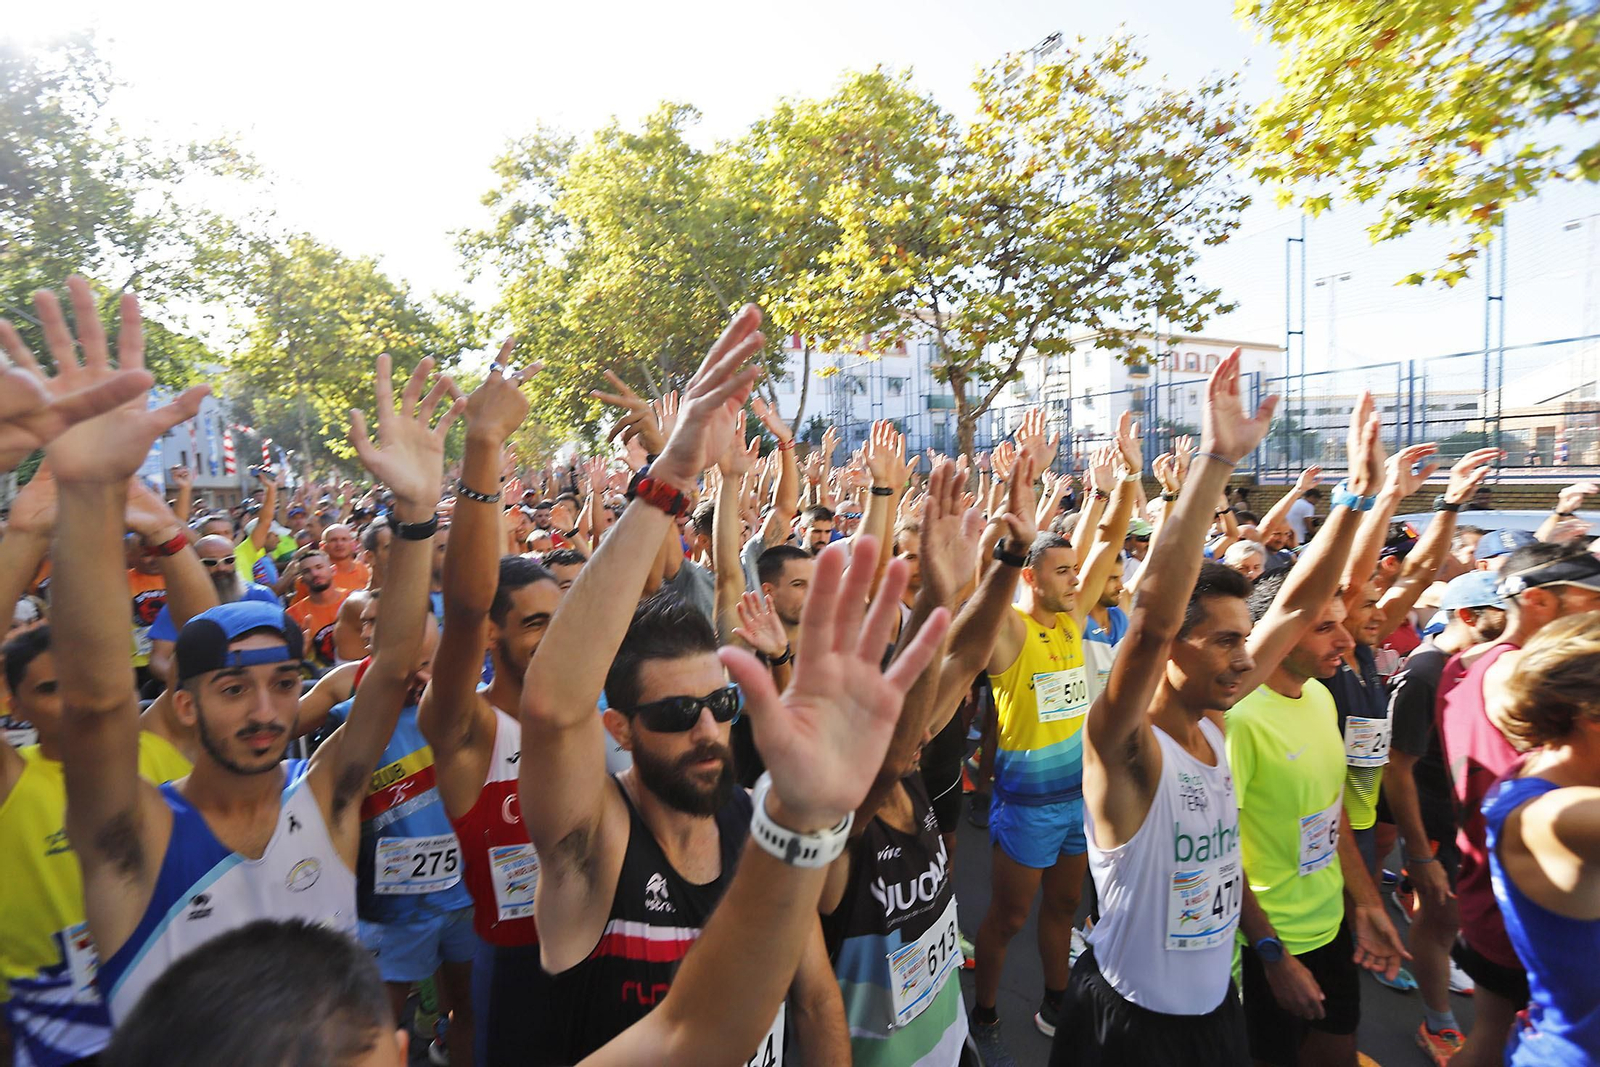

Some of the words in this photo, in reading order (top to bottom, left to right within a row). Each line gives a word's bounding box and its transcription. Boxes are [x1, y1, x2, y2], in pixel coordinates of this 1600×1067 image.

[1064, 679, 1087, 704] 500
[411, 848, 458, 878] 275
[927, 920, 956, 977] 613
